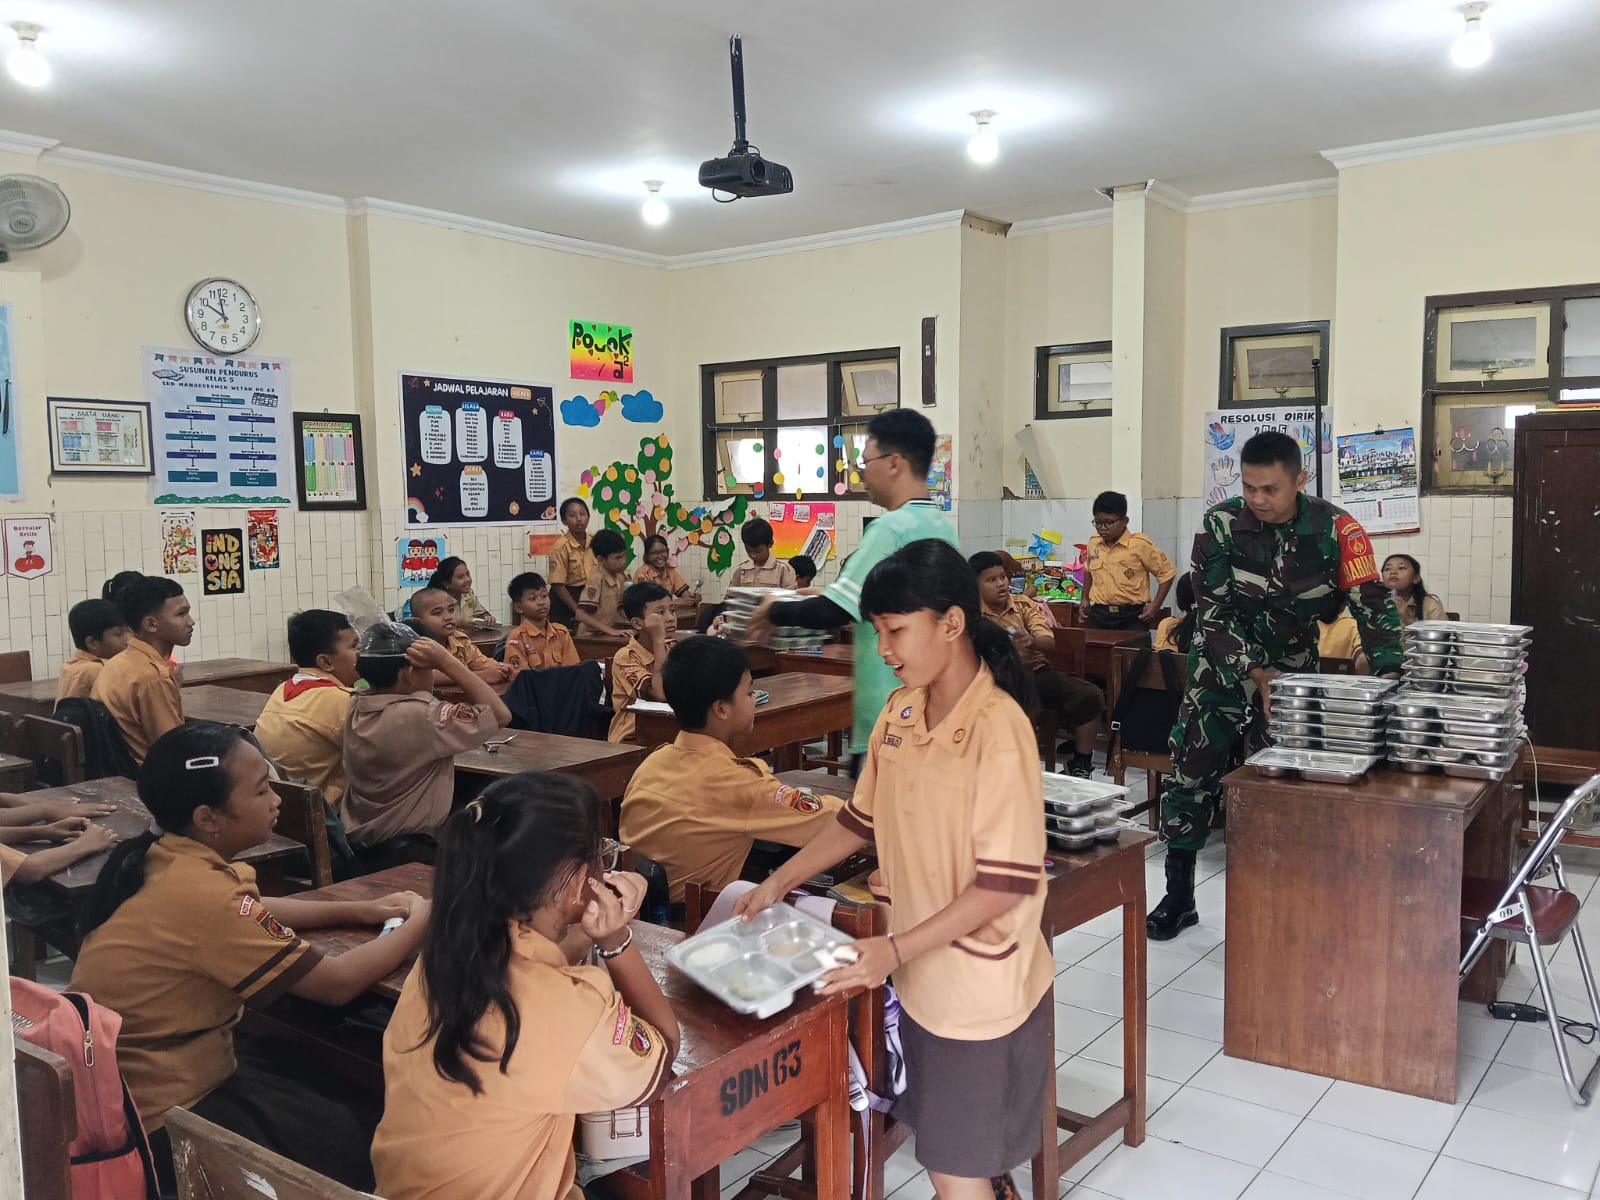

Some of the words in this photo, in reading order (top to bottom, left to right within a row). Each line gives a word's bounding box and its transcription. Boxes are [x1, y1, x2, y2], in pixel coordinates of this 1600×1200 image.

[209, 290, 216, 299] 11
[200, 297, 209, 307] 10
[240, 302, 246, 312] 2
[197, 309, 204, 318] 9
[242, 314, 249, 324] 3
[201, 321, 208, 331] 8
[240, 326, 246, 335] 4
[209, 331, 216, 340] 7
[220, 336, 227, 345] 6
[232, 333, 238, 342] 5
[179, 366, 216, 375] SUSUNAN
[205, 375, 227, 383] KELAS
[432, 382, 465, 394] JADWAL
[465, 384, 509, 397] PELAJARAN
[1220, 412, 1276, 424] RESOLUSI
[1284, 411, 1323, 421] DIRIK
[204, 552, 241, 570] ONE
[207, 569, 241, 591] SIA
[720, 1058, 768, 1117] SDN
[773, 1039, 802, 1087] 63
